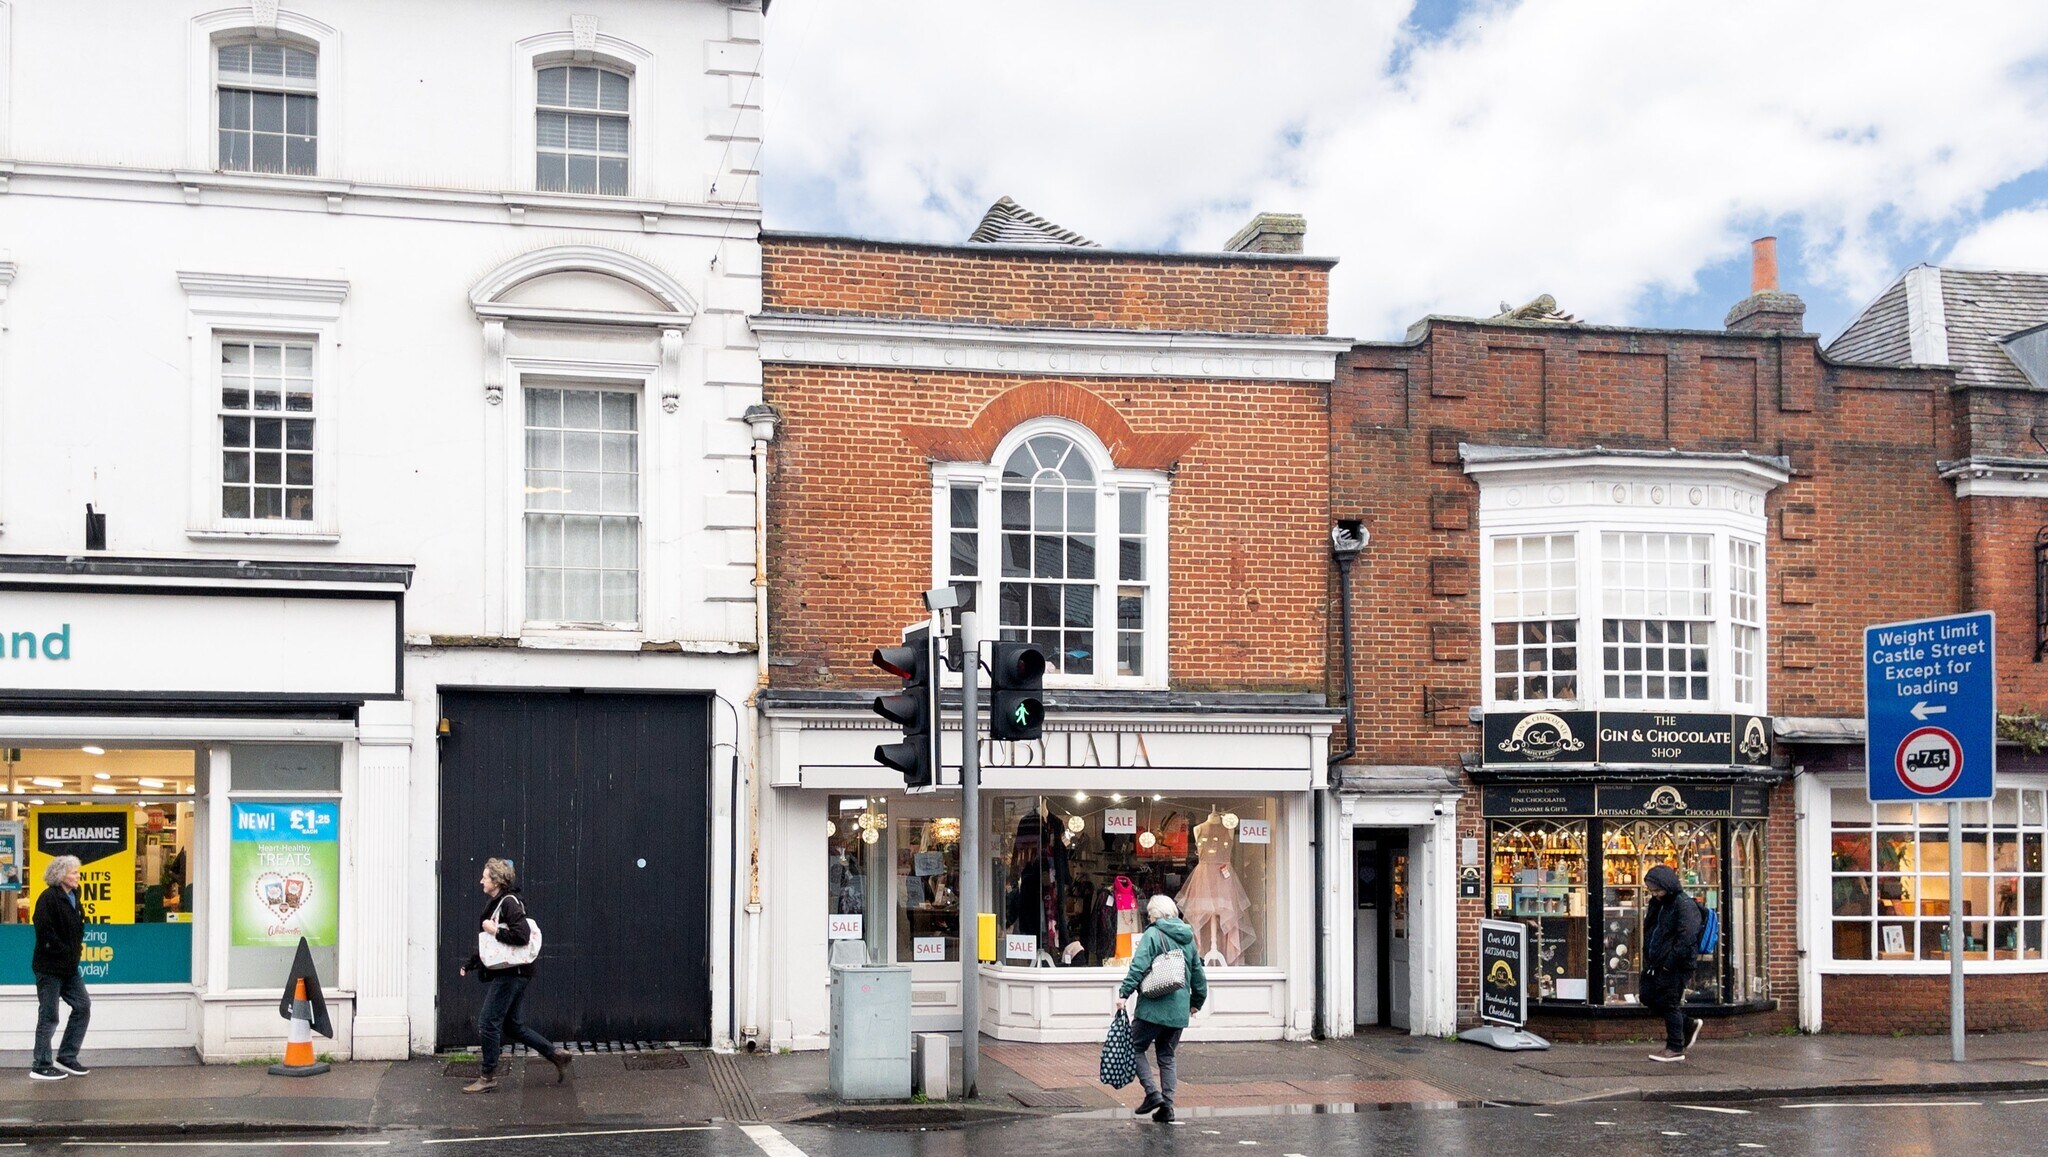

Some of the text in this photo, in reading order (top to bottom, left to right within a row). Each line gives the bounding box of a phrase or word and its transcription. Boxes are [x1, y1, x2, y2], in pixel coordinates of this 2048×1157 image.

[1879, 622, 1978, 646] Weight limit
[0, 624, 70, 660] nd
[1872, 640, 1985, 664] Castle Street
[1886, 660, 1971, 680] Except for
[1897, 680, 1958, 696] loading
[1654, 715, 1676, 726] THE
[1600, 729, 1628, 742] GIN
[1631, 729, 1644, 742] &
[1646, 729, 1731, 744] CHOCOLATE
[1651, 747, 1682, 759] SHOP
[1685, 808, 1731, 816] CHOCOLATES
[238, 812, 275, 831] NEW!
[1107, 816, 1133, 827] SALE
[45, 827, 120, 839] CLEARANCE
[1242, 826, 1268, 837] SALE
[258, 844, 311, 853] Heart-Healthy
[257, 853, 312, 866] TREATS
[91, 872, 111, 881] IT'S
[80, 883, 112, 901] NE
[832, 921, 859, 932] SALE
[83, 930, 108, 943] zing
[1501, 935, 1516, 947] 400
[80, 943, 114, 962] lue
[916, 943, 942, 954] SALE
[1008, 941, 1033, 953] SALE
[78, 963, 109, 977] yday!
